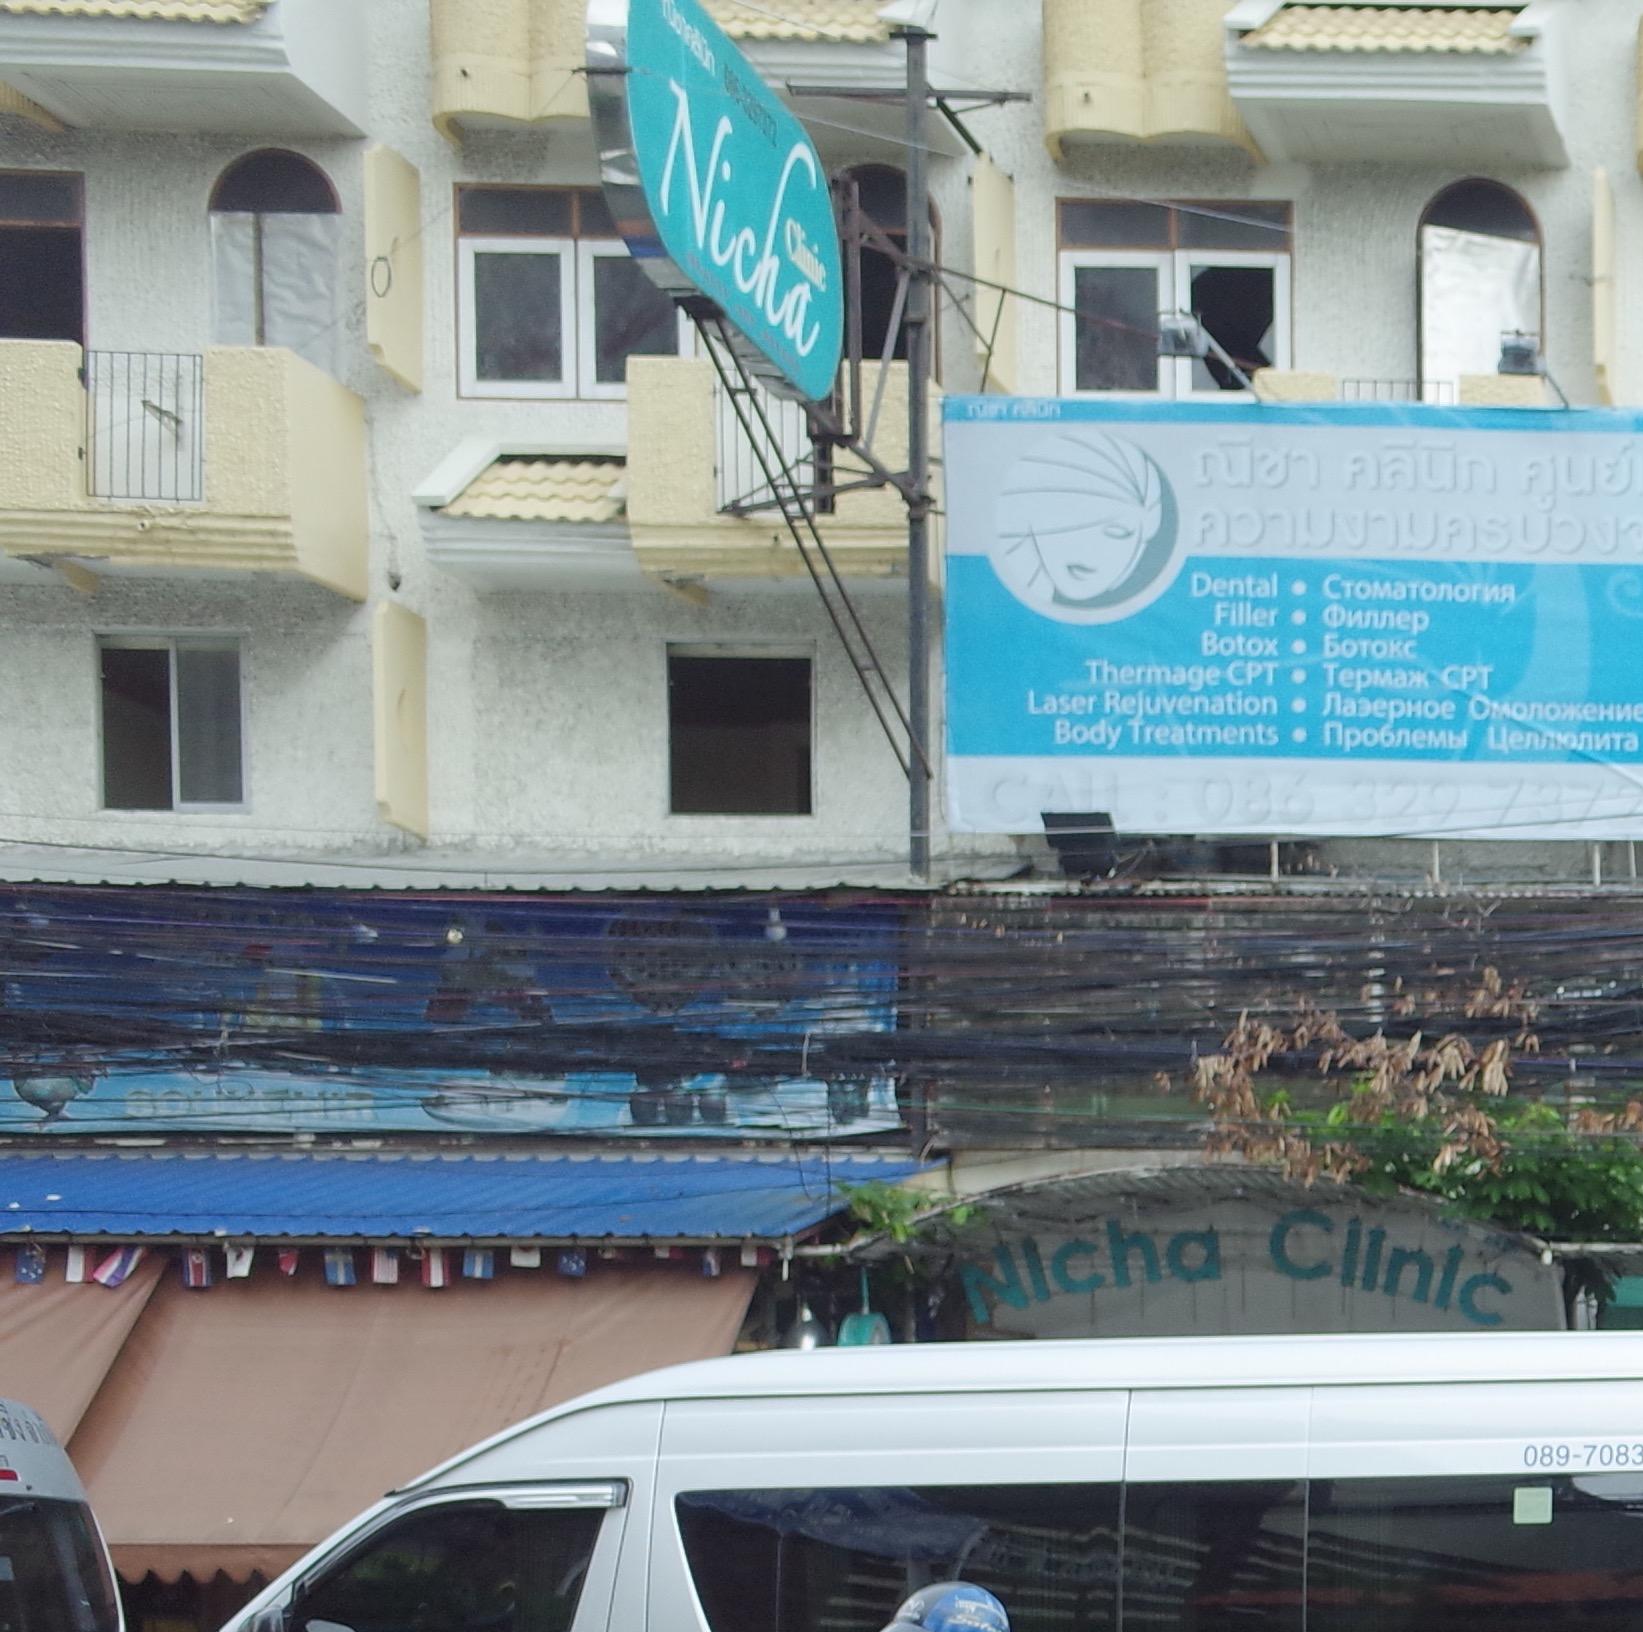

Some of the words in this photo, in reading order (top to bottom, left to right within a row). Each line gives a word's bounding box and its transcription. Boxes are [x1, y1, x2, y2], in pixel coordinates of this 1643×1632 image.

[660, 78, 821, 357] Nicha
[1196, 437, 1320, 489] ณิชา
[1345, 440, 1498, 495] คลินิก
[1191, 571, 1278, 598] Dental
[1322, 573, 1517, 603] Стоматология
[1214, 601, 1278, 628] Filler
[1322, 603, 1430, 634] Филлер
[1201, 630, 1279, 656] Botox
[1322, 633, 1418, 659] Ботокс
[1086, 658, 1220, 691] Thermage
[1226, 661, 1278, 686] CPT
[1322, 663, 1430, 692] Термаж
[1028, 690, 1097, 715] Laser
[1104, 690, 1278, 718] Rejuvenation
[1055, 719, 1122, 750] Body
[1128, 720, 1280, 747] Treatments
[1322, 721, 1468, 751] Проблемы
